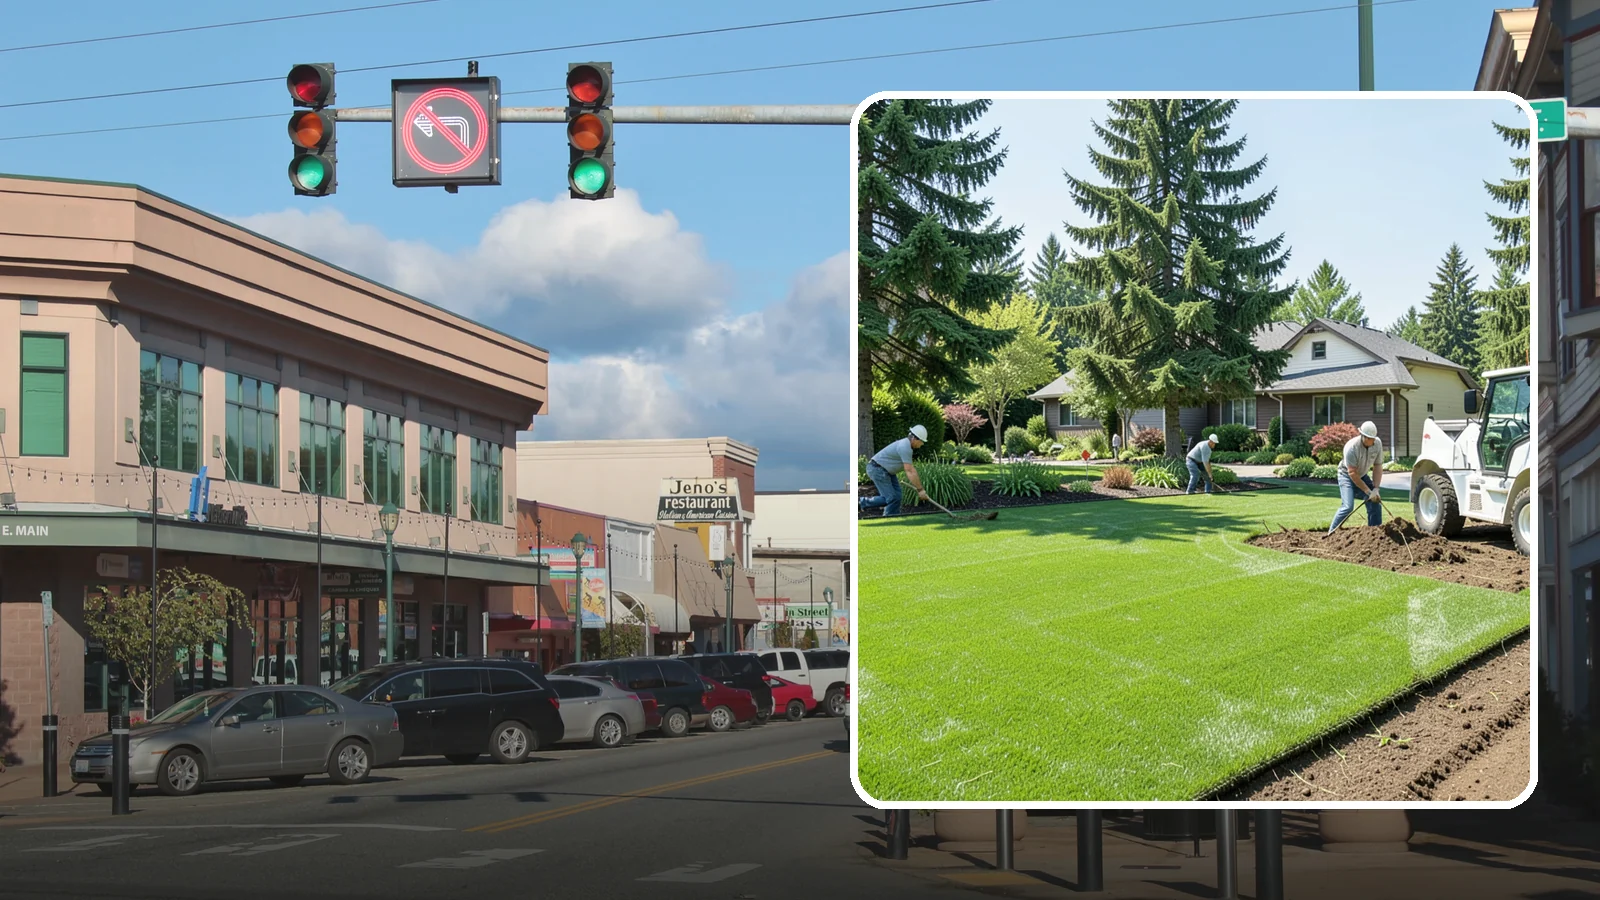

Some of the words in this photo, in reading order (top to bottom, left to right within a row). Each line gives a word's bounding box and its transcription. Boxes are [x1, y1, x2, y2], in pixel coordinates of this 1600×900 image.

[670, 480, 727, 494] Jeno's
[665, 496, 730, 508] restaurant
[659, 510, 681, 519] Italian
[686, 510, 714, 518] American
[715, 510, 737, 518] Cuisine
[2, 525, 13, 536] E.
[15, 525, 49, 536] MAIN
[797, 608, 828, 616] Street
